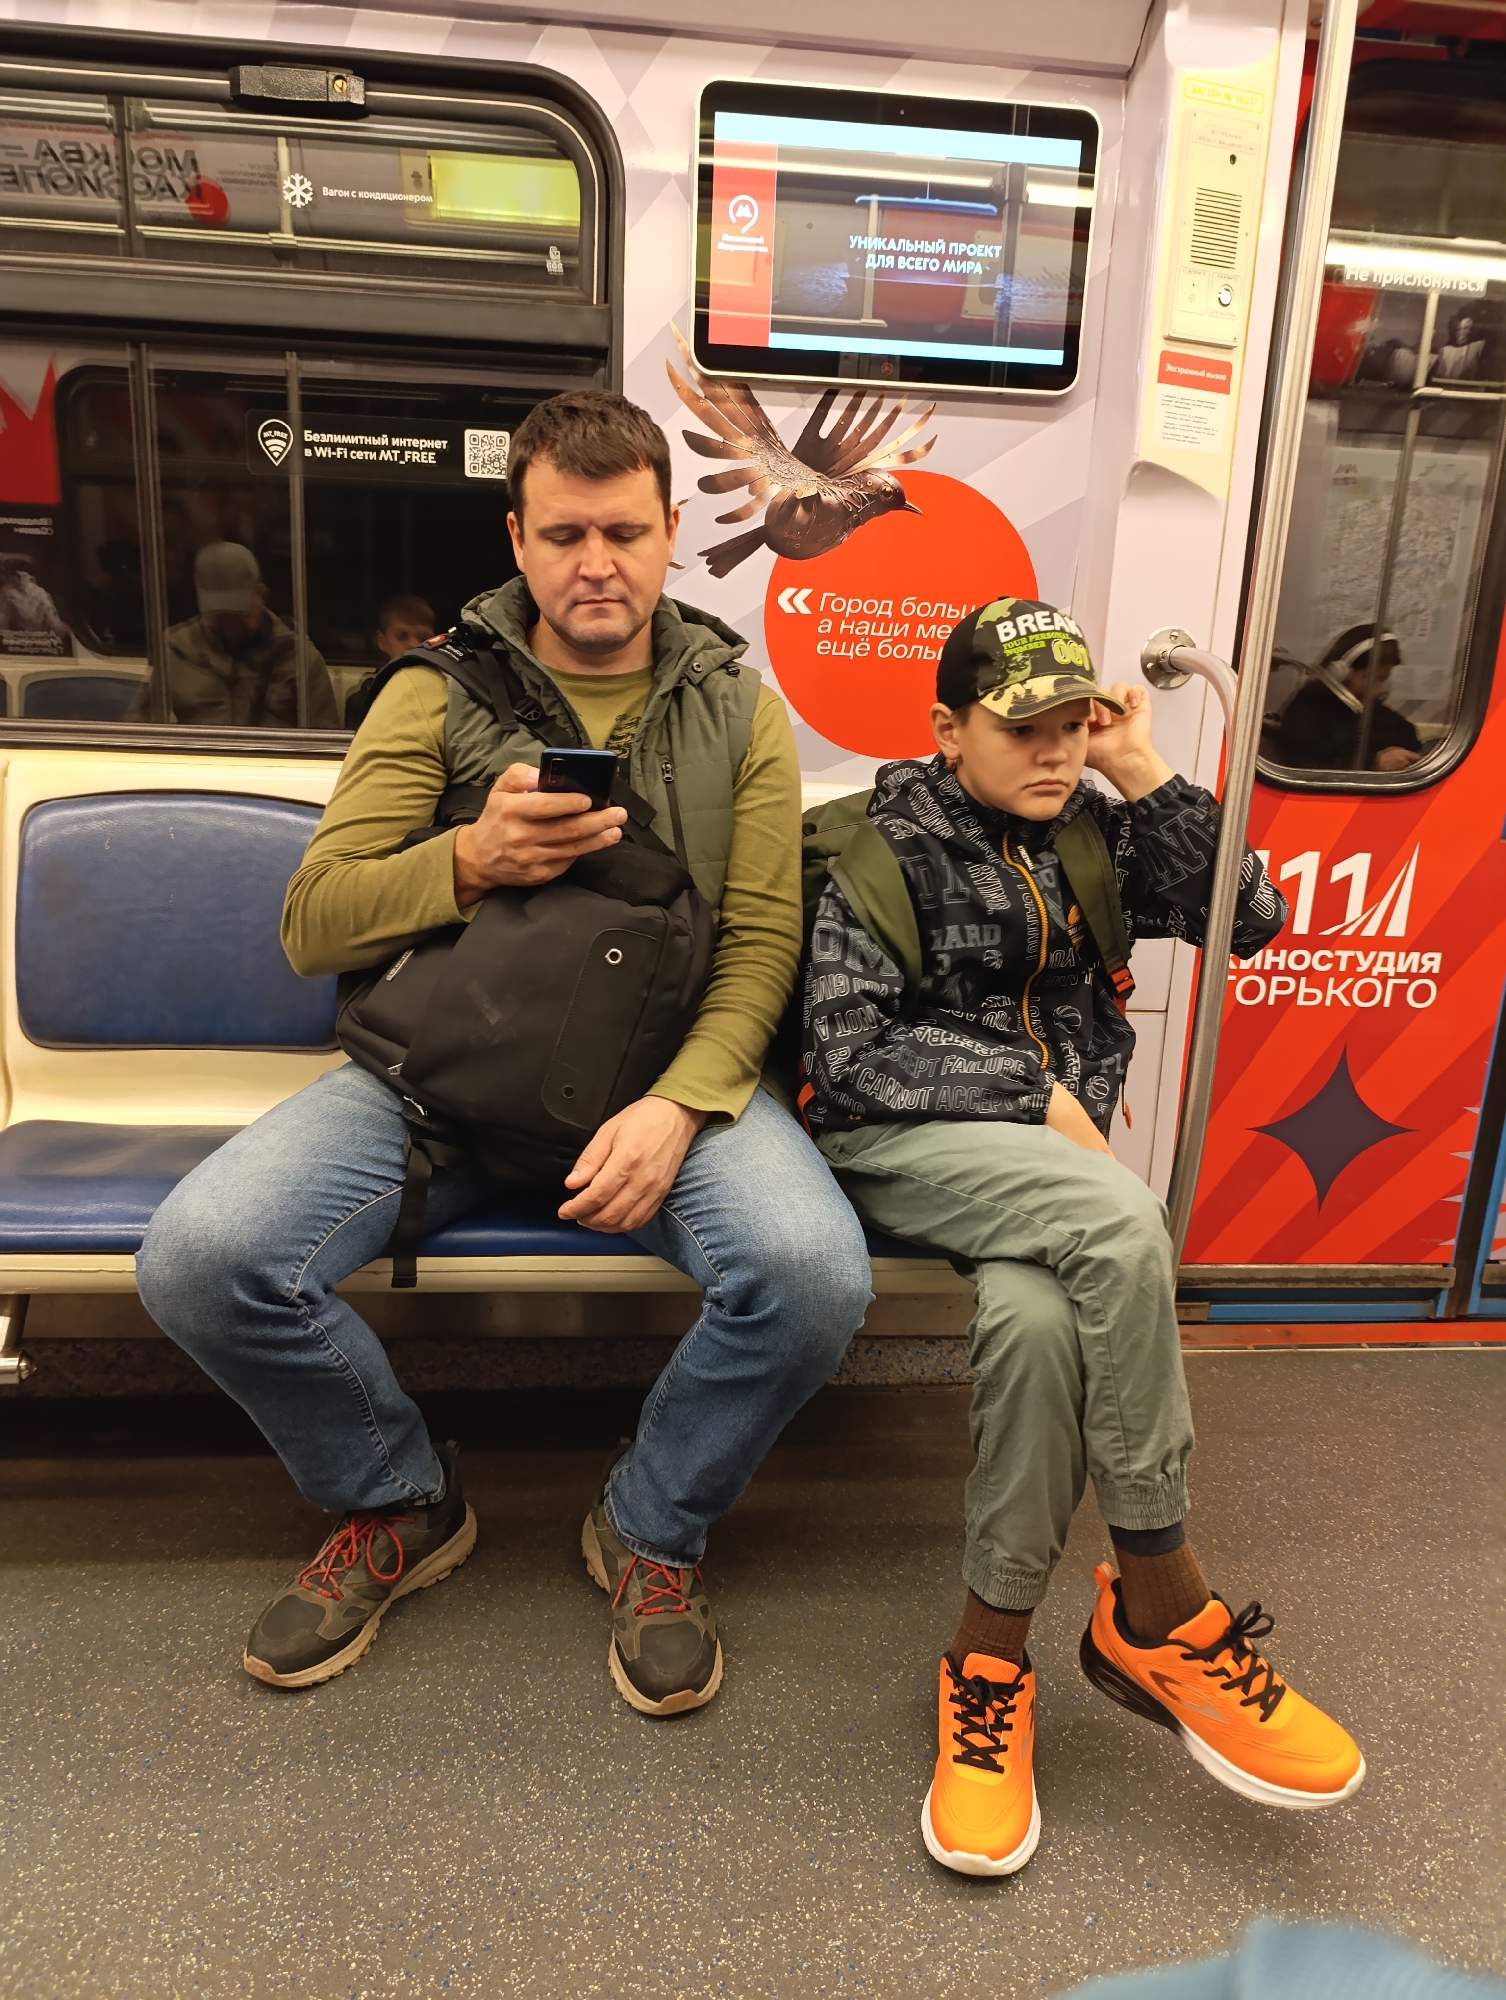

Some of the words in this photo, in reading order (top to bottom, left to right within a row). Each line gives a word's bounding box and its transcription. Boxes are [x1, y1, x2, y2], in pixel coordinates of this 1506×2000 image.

[322, 186, 350, 198] Вагон
[351, 190, 357, 198] с
[358, 189, 433, 203] кондиционером
[849, 235, 946, 255] УНИКАЛЬНЫЙ
[949, 242, 1002, 258] ПРОЕКТ
[865, 253, 895, 269] ДЛЯ
[898, 256, 940, 272] ВСЕГО
[943, 259, 983, 275] МИРА
[1346, 267, 1369, 282] Не
[1373, 270, 1486, 292] прислоняться
[1164, 362, 1206, 379] Экстренный
[1206, 371, 1227, 382] вызов
[303, 430, 389, 447] Безлимитный
[391, 437, 448, 449] интернет
[314, 447, 348, 459] Wi-Fi
[350, 451, 376, 461] сети
[379, 450, 436, 464] MT_FREE
[819, 592, 893, 618] Город
[817, 618, 833, 634] а
[839, 619, 909, 637] наши
[916, 623, 956, 640] ме
[995, 610, 1083, 643] BREAK
[816, 638, 870, 660] ещё
[877, 638, 944, 661] боль
[1002, 637, 1027, 651] YOUR
[1029, 631, 1072, 644] PERSONAL
[1003, 641, 1047, 657] NUMBER
[935, 1085, 1014, 1114] ACCEPT
